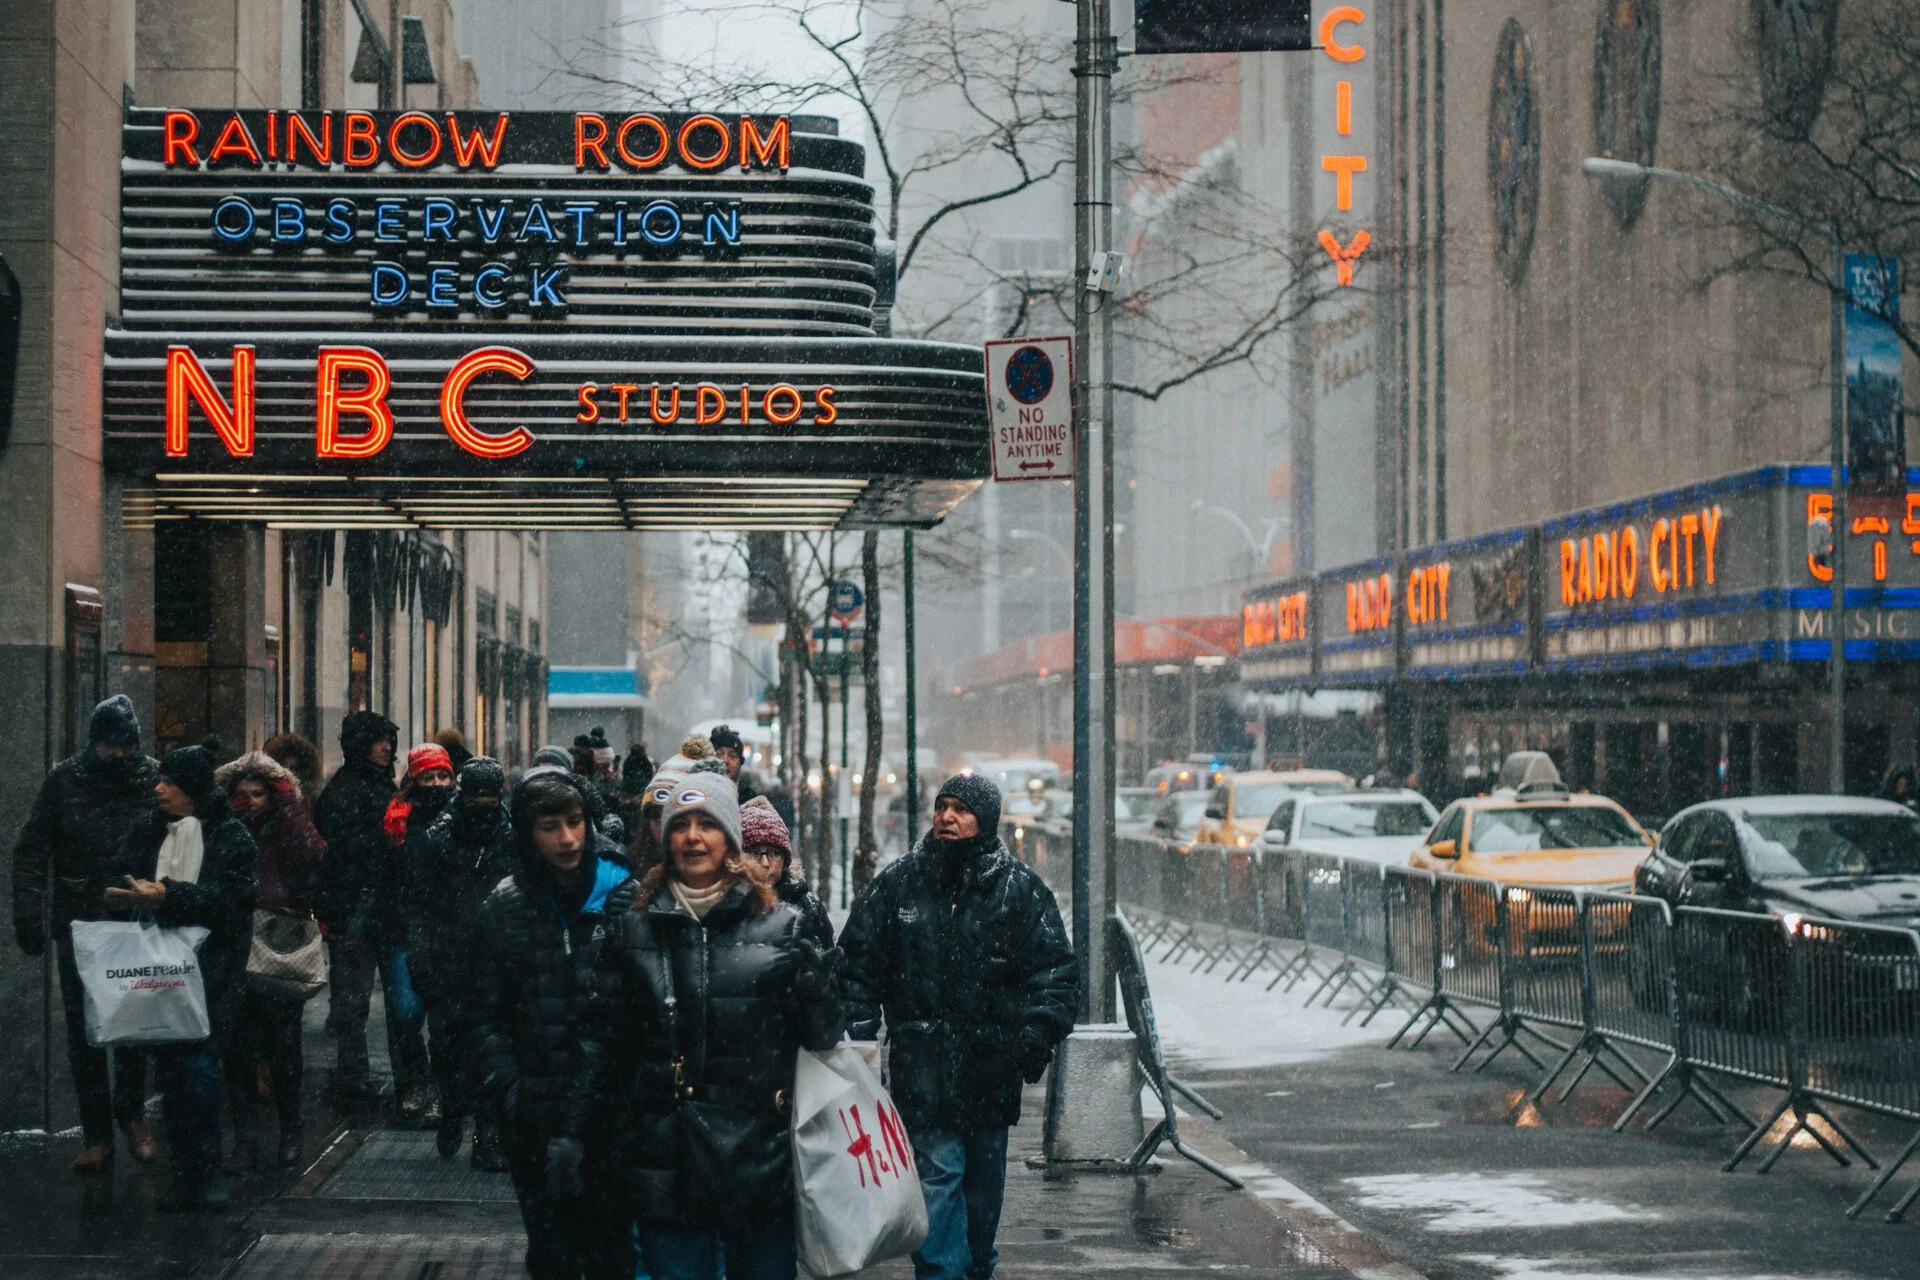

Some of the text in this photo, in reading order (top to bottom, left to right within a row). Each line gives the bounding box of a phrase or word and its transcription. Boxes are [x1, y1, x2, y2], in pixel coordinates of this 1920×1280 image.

[163, 109, 790, 173] RAINBOW ROOM
[1317, 5, 1372, 287] CITY
[211, 196, 742, 246] OBSERVATION
[370, 261, 568, 307] DECK
[166, 344, 838, 458] NBC STUDIOS
[1018, 407, 1044, 424] NO
[1000, 424, 1067, 444] STANDING
[1006, 442, 1063, 459] ANYTIME
[1560, 526, 1638, 607] RADIO
[1650, 504, 1721, 593] CITY
[1407, 562, 1450, 625] CITY
[838, 1099, 916, 1189] H&M
